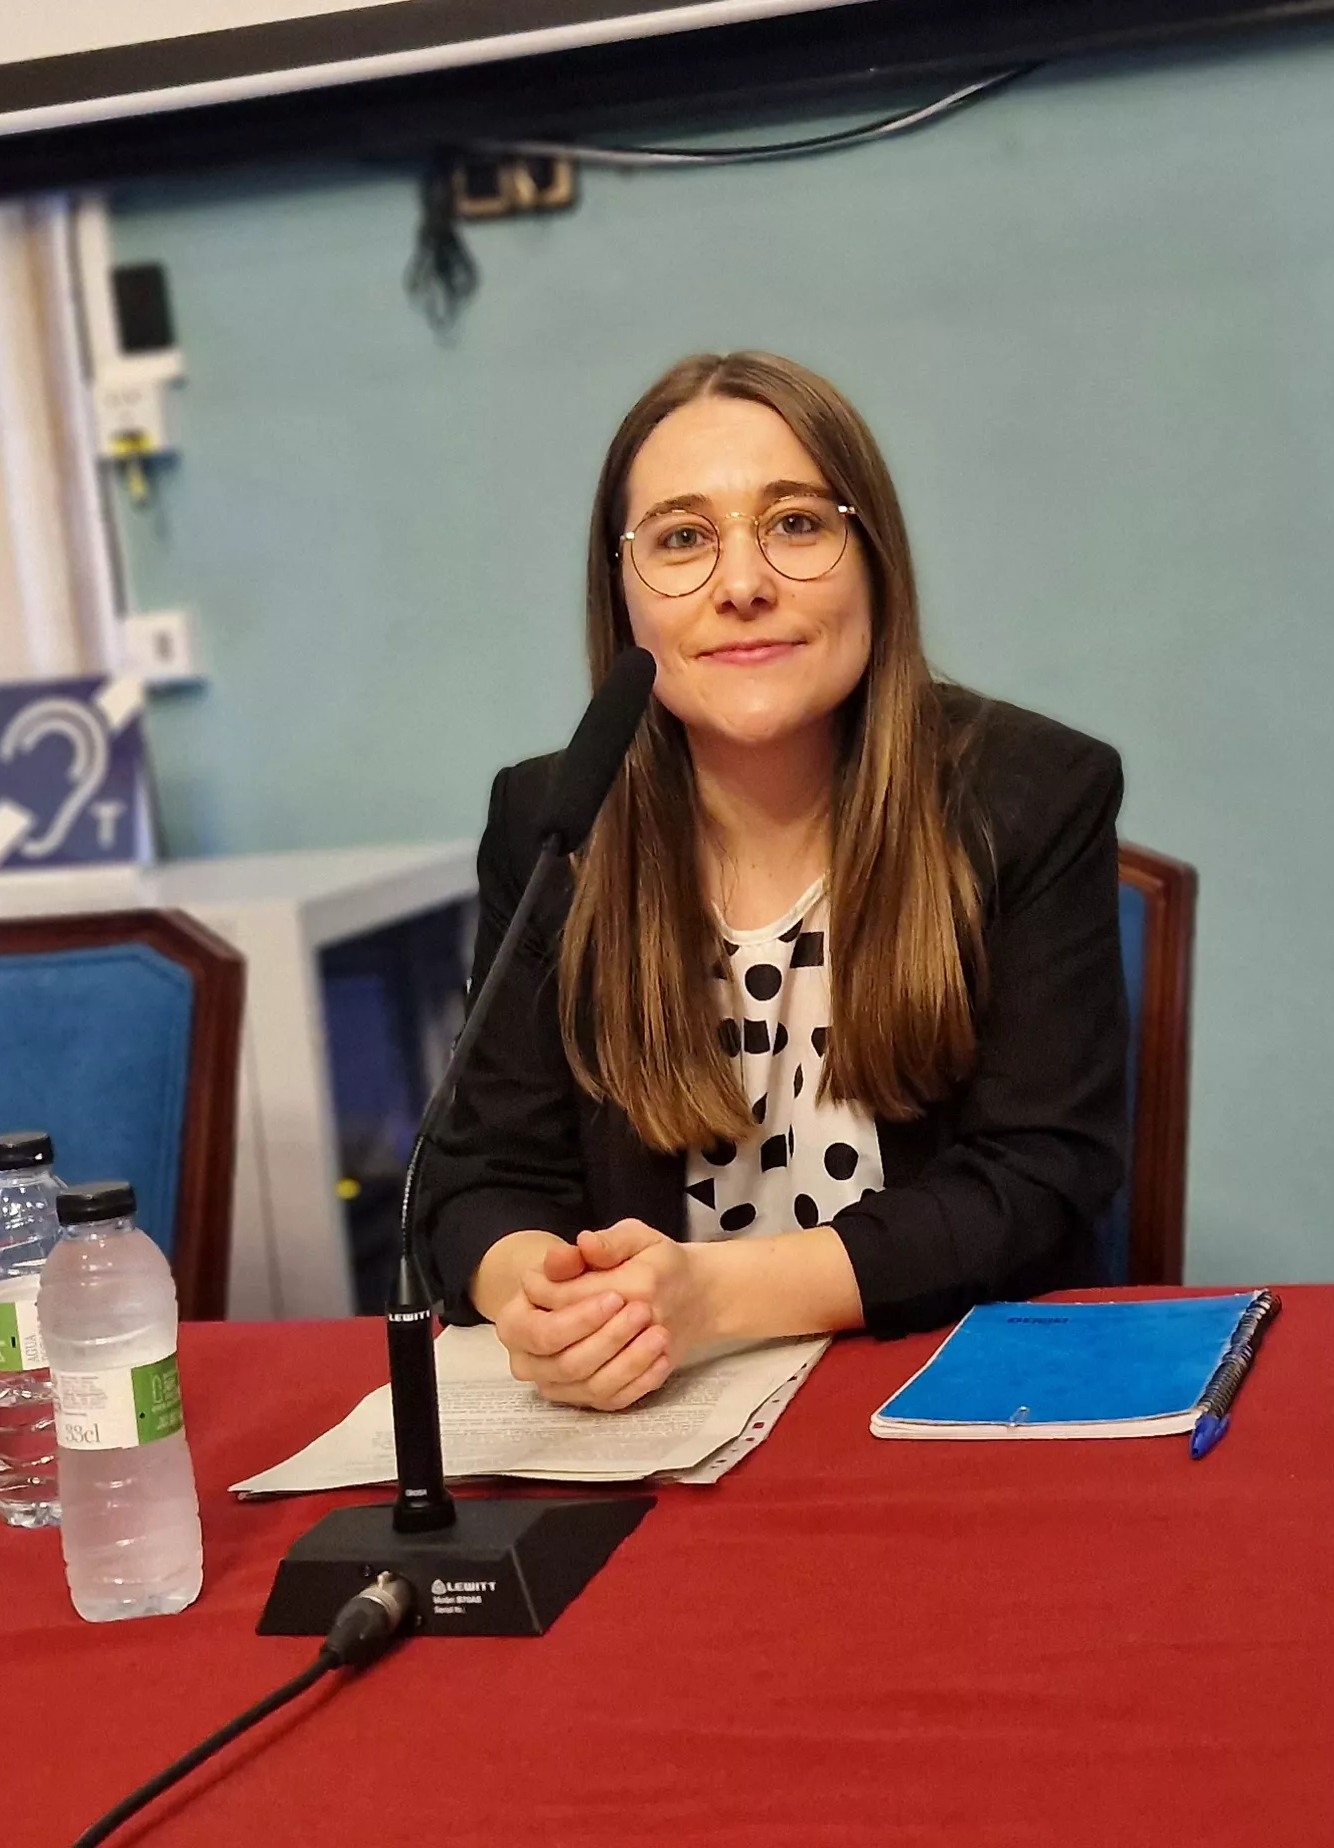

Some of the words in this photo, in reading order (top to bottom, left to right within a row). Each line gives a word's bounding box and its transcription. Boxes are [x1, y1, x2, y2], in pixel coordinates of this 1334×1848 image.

[90, 801, 127, 848] T
[65, 1422, 101, 1444] 33cl
[447, 1581, 496, 1592] LEWITT
